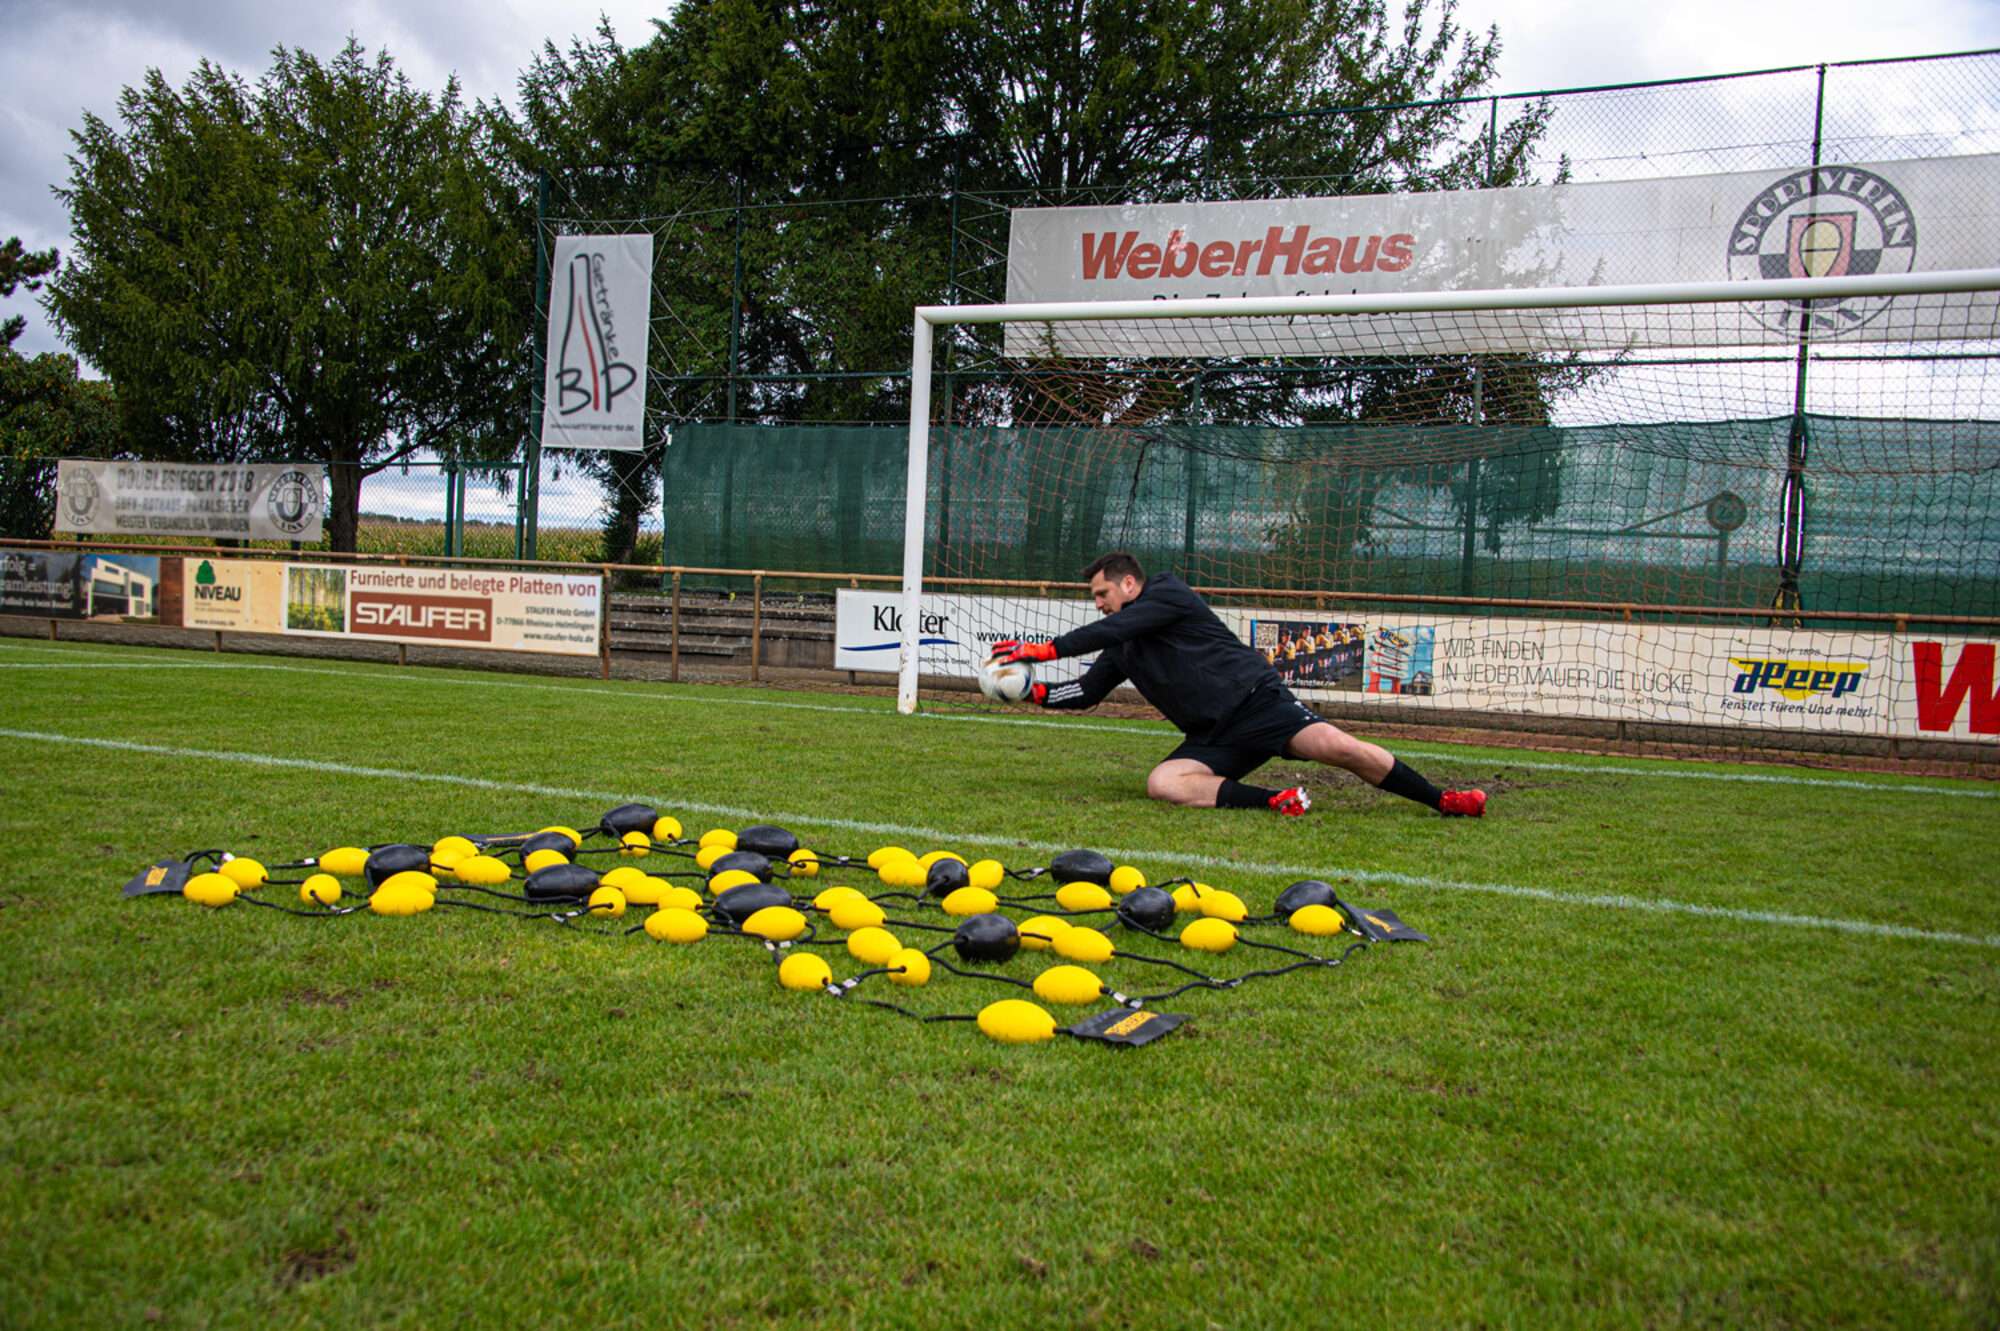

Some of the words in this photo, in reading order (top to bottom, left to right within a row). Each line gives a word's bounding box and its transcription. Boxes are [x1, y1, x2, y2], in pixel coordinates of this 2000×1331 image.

[1082, 225, 1416, 280] WeberHaus
[592, 253, 619, 360] Getränke
[194, 585, 241, 602] NIVEAU
[351, 570, 414, 588] Furnierte
[418, 574, 446, 589] und
[450, 574, 505, 595] belegte
[509, 577, 564, 595] Platten
[567, 584, 596, 597] von
[355, 602, 486, 631] STAUFER
[872, 605, 949, 634] Klter
[1443, 638, 1476, 657] WIR
[1481, 640, 1544, 660] FINDEN
[1442, 662, 1458, 681] IN
[1463, 664, 1519, 684] JEDER
[1525, 666, 1590, 688] MAUER
[1596, 669, 1624, 690] DIE
[1807, 703, 1833, 716] Und
[1835, 706, 1873, 718] mehr!
